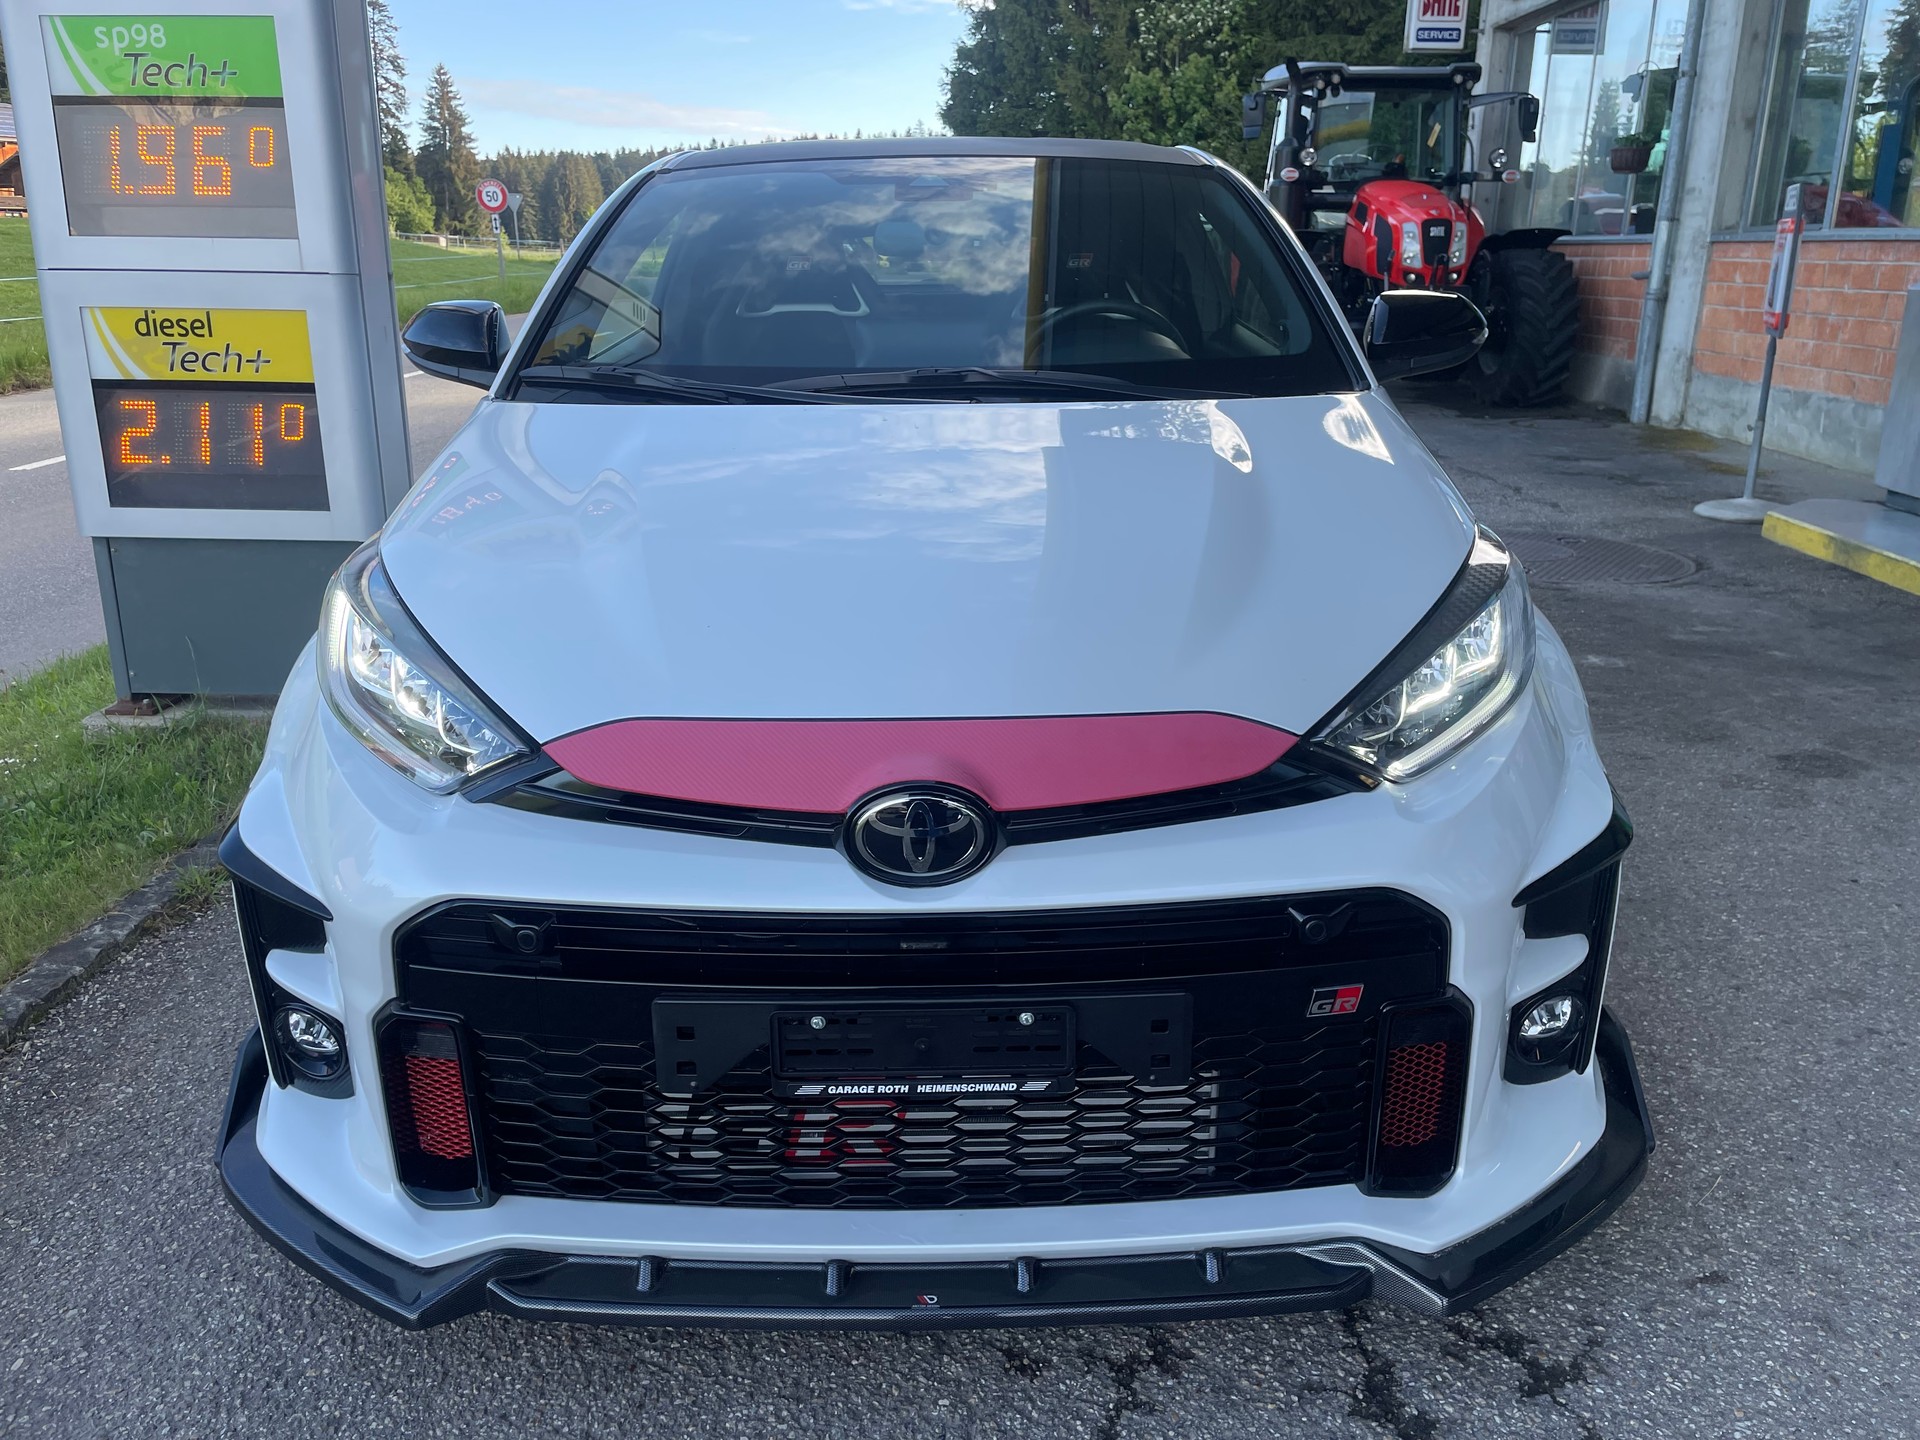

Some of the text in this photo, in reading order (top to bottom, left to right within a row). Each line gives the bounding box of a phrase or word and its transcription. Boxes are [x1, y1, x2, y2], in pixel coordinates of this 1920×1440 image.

[94, 24, 167, 55] sp98
[1417, 30, 1460, 40] SERVICE
[123, 52, 238, 88] Tech+
[485, 190, 499, 203] 50
[134, 310, 213, 338] diesel
[162, 341, 272, 374] Tech+
[1310, 995, 1358, 1014] GR
[828, 1083, 1018, 1094] GARAGE ROTH HEIMENSCHWAND
